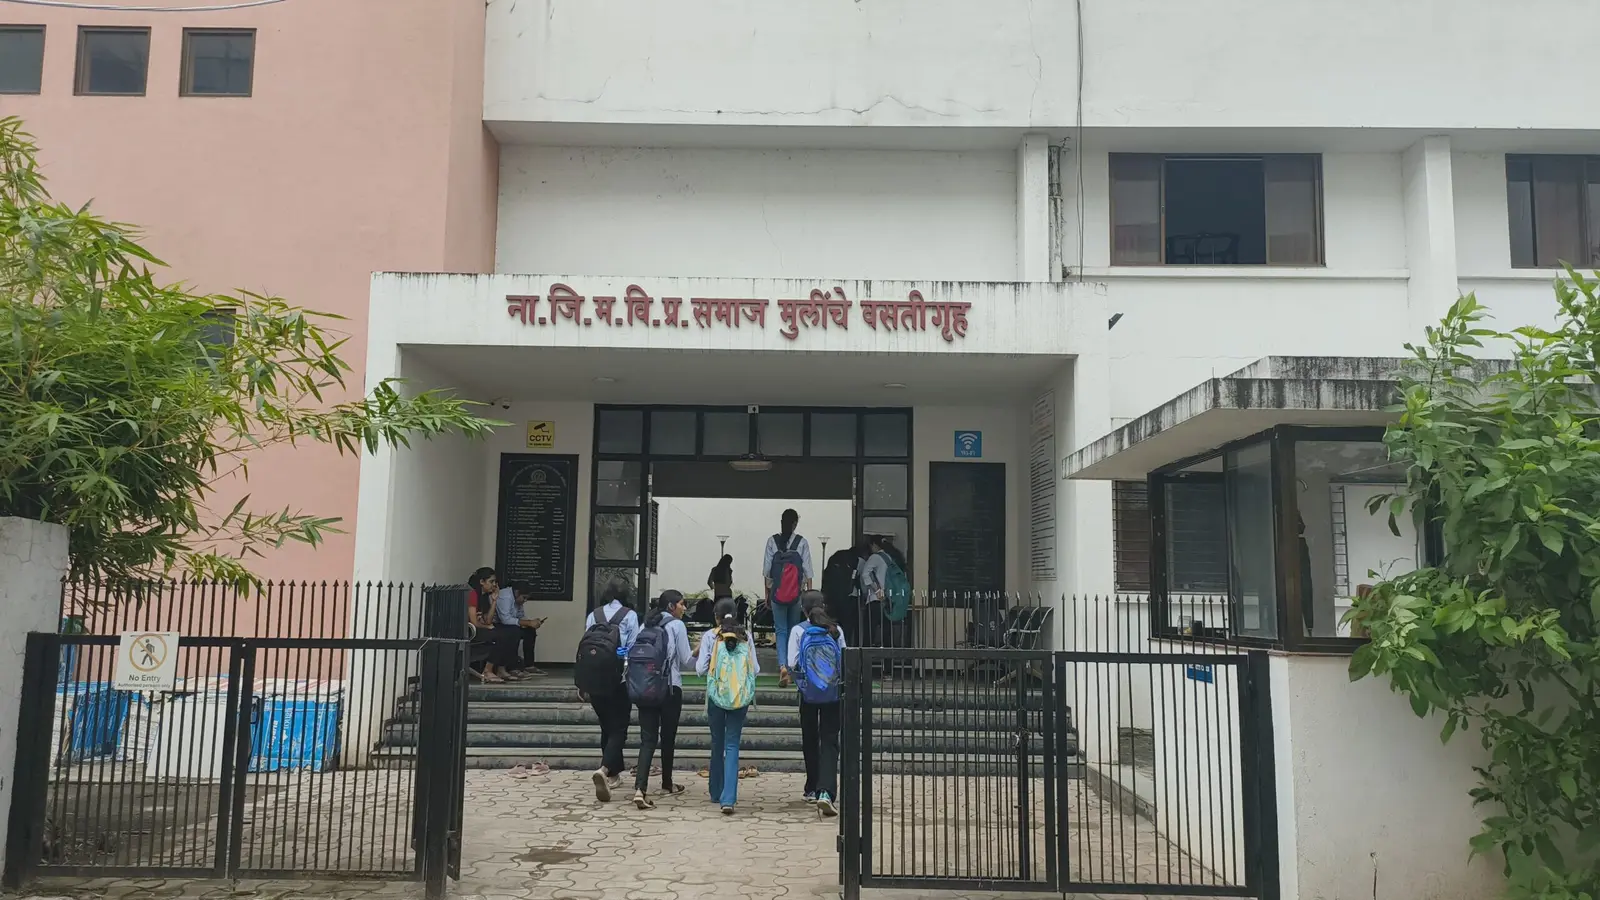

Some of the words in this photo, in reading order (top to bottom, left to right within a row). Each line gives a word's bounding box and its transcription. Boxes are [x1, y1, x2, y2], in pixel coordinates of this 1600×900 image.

[777, 286, 852, 340] मुलींचे
[860, 289, 972, 342] वसतीगृह
[529, 434, 552, 442] CCTV
[128, 674, 140, 682] No
[141, 674, 161, 683] Entry
